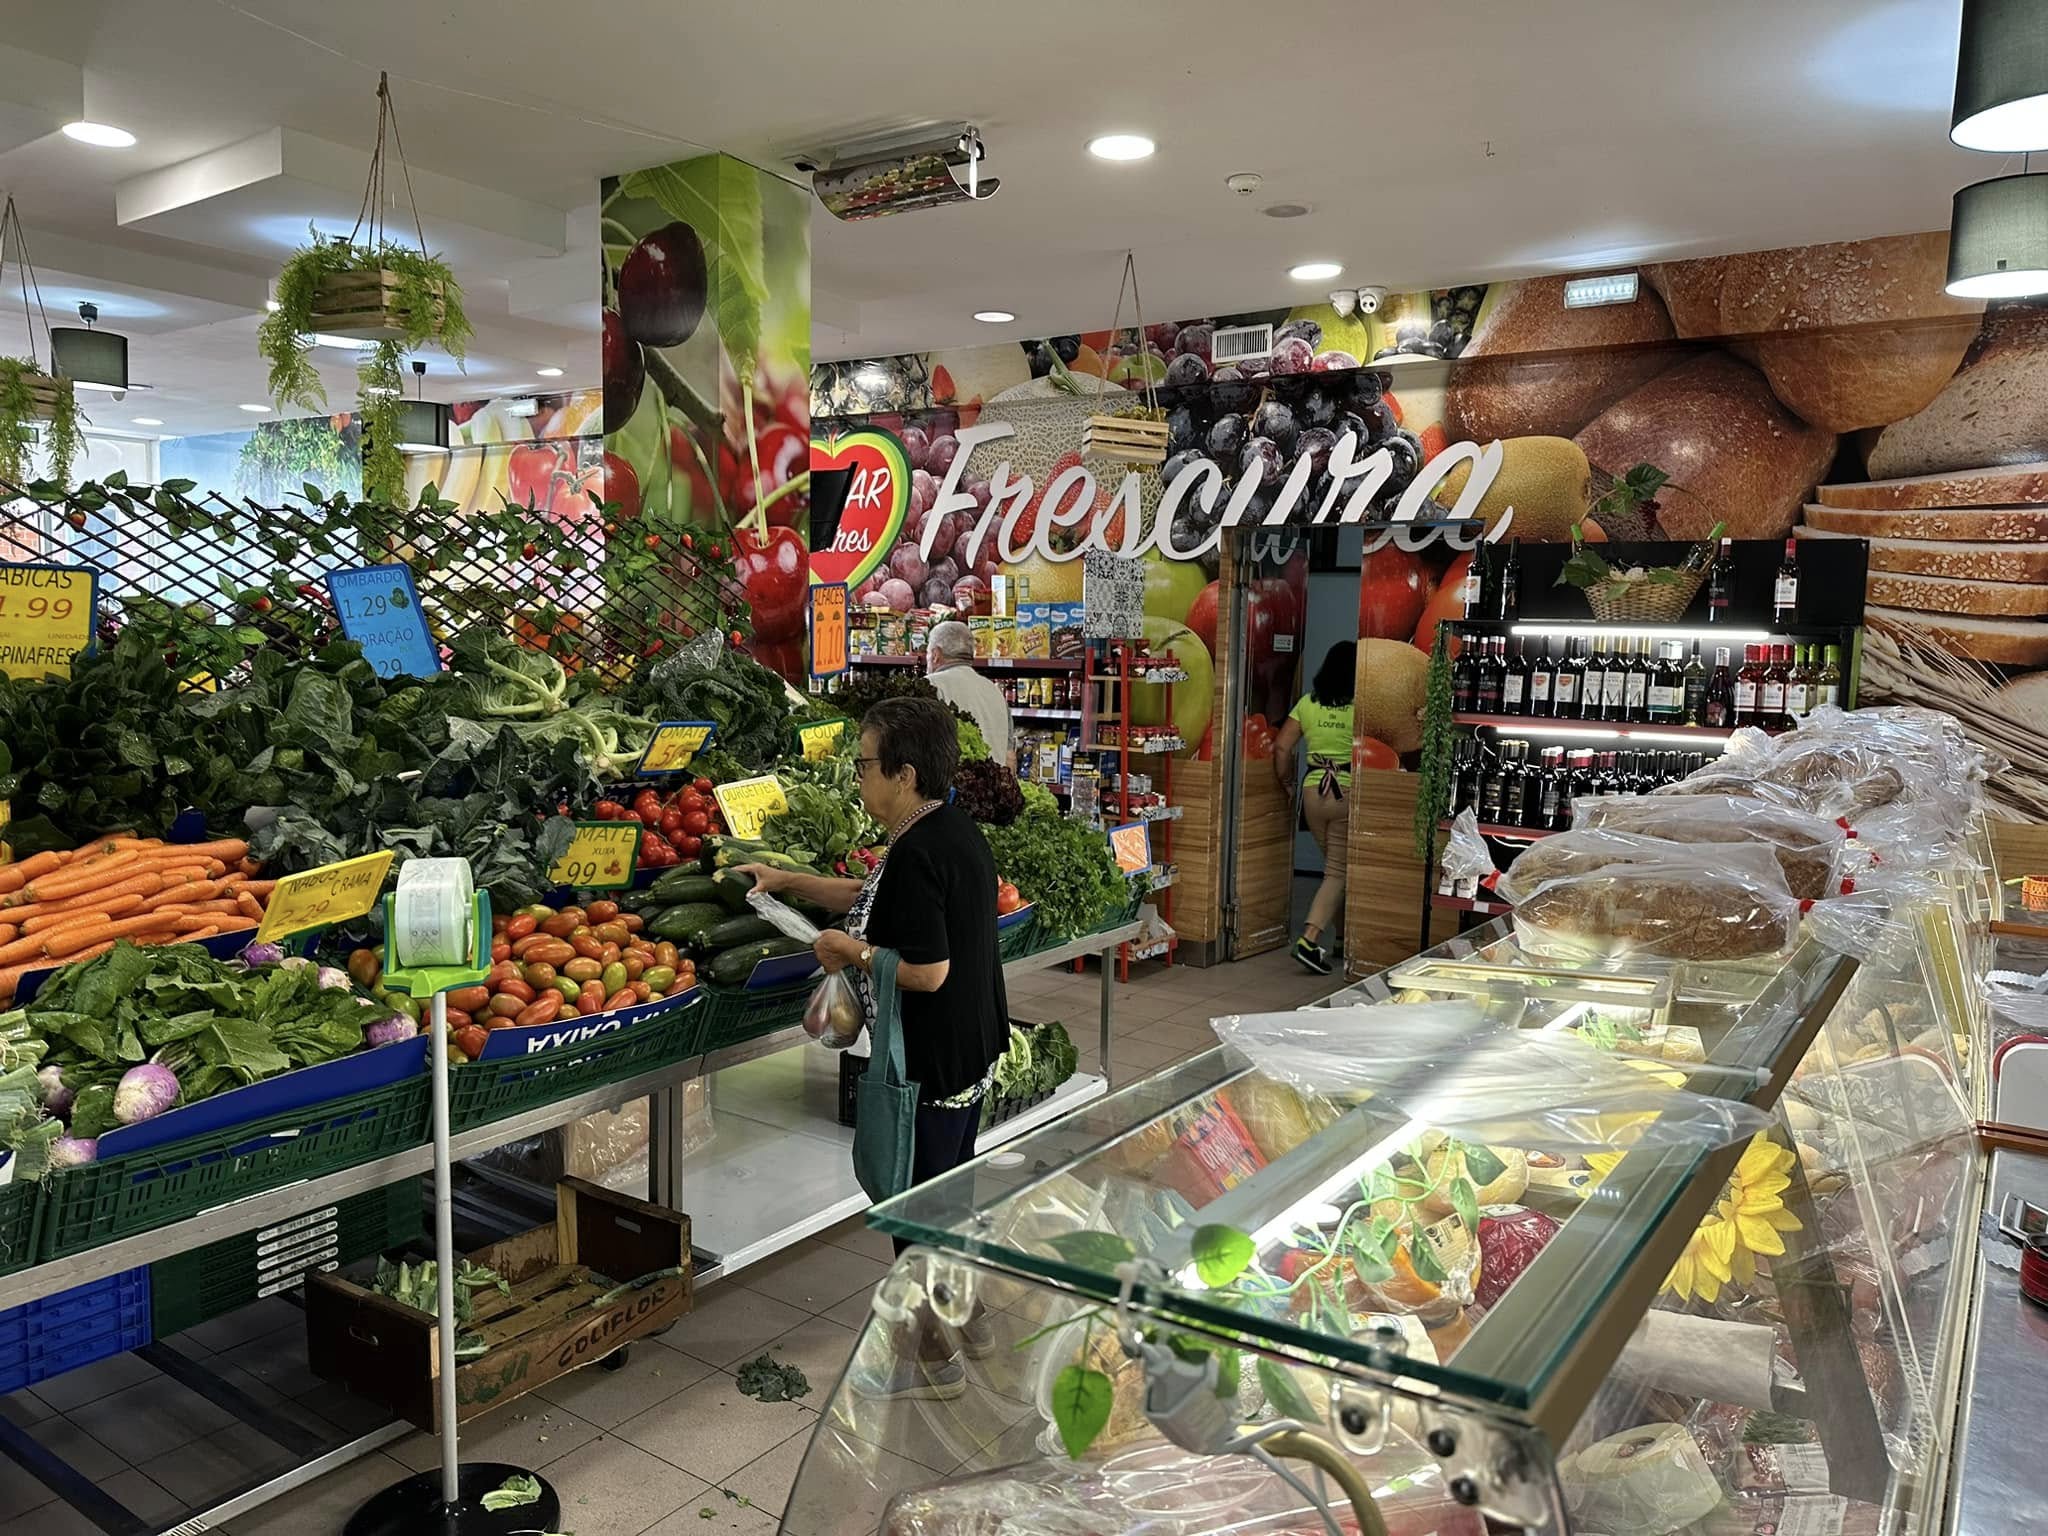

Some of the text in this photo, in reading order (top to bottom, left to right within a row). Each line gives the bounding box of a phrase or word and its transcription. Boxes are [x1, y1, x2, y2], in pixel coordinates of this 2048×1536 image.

[919, 421, 1513, 569] Frescura
[343, 594, 387, 619] 1.29
[815, 625, 843, 666] 1.10
[731, 808, 767, 834] 1.19
[592, 847, 616, 856] XUXA
[557, 1286, 666, 1368] COLIFLOR
